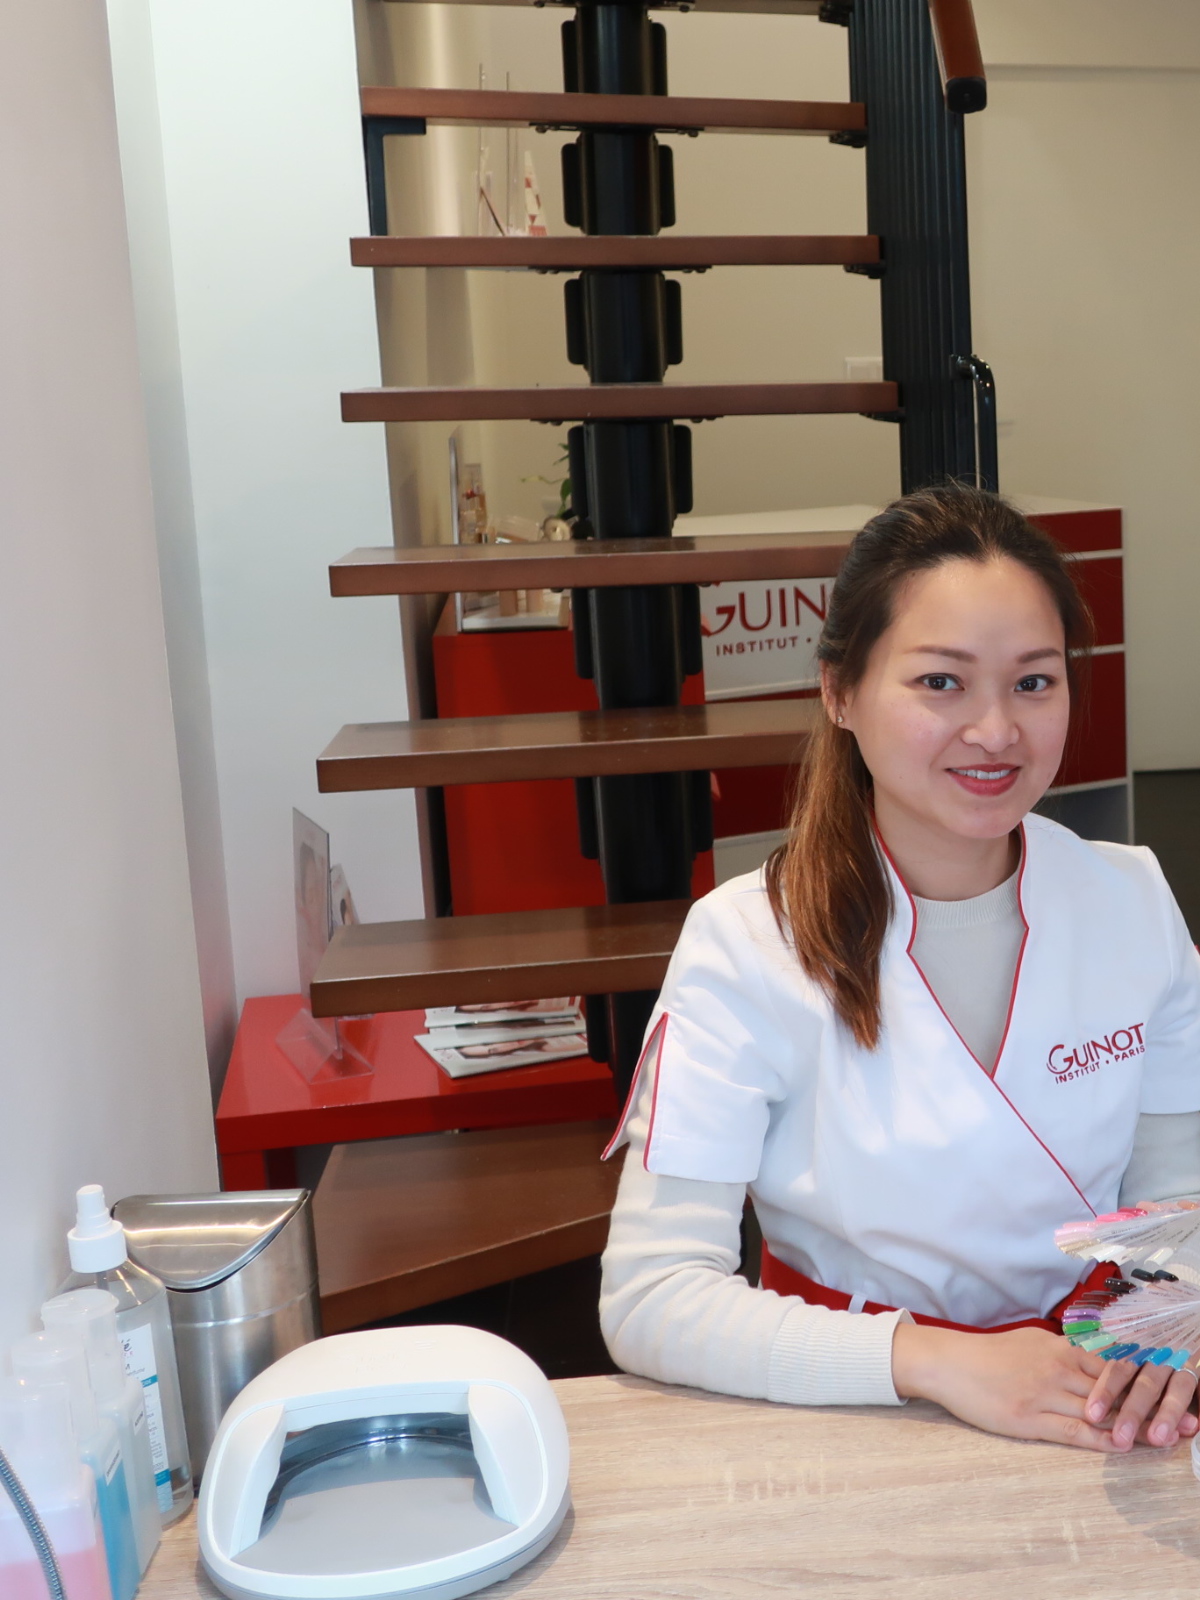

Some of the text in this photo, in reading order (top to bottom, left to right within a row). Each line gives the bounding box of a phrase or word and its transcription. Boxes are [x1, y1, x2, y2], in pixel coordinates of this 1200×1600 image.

[716, 636, 798, 656] INSTITUT
[1046, 1022, 1144, 1075] GUINOT
[1055, 1044, 1146, 1084] INSTITUT PARIS
